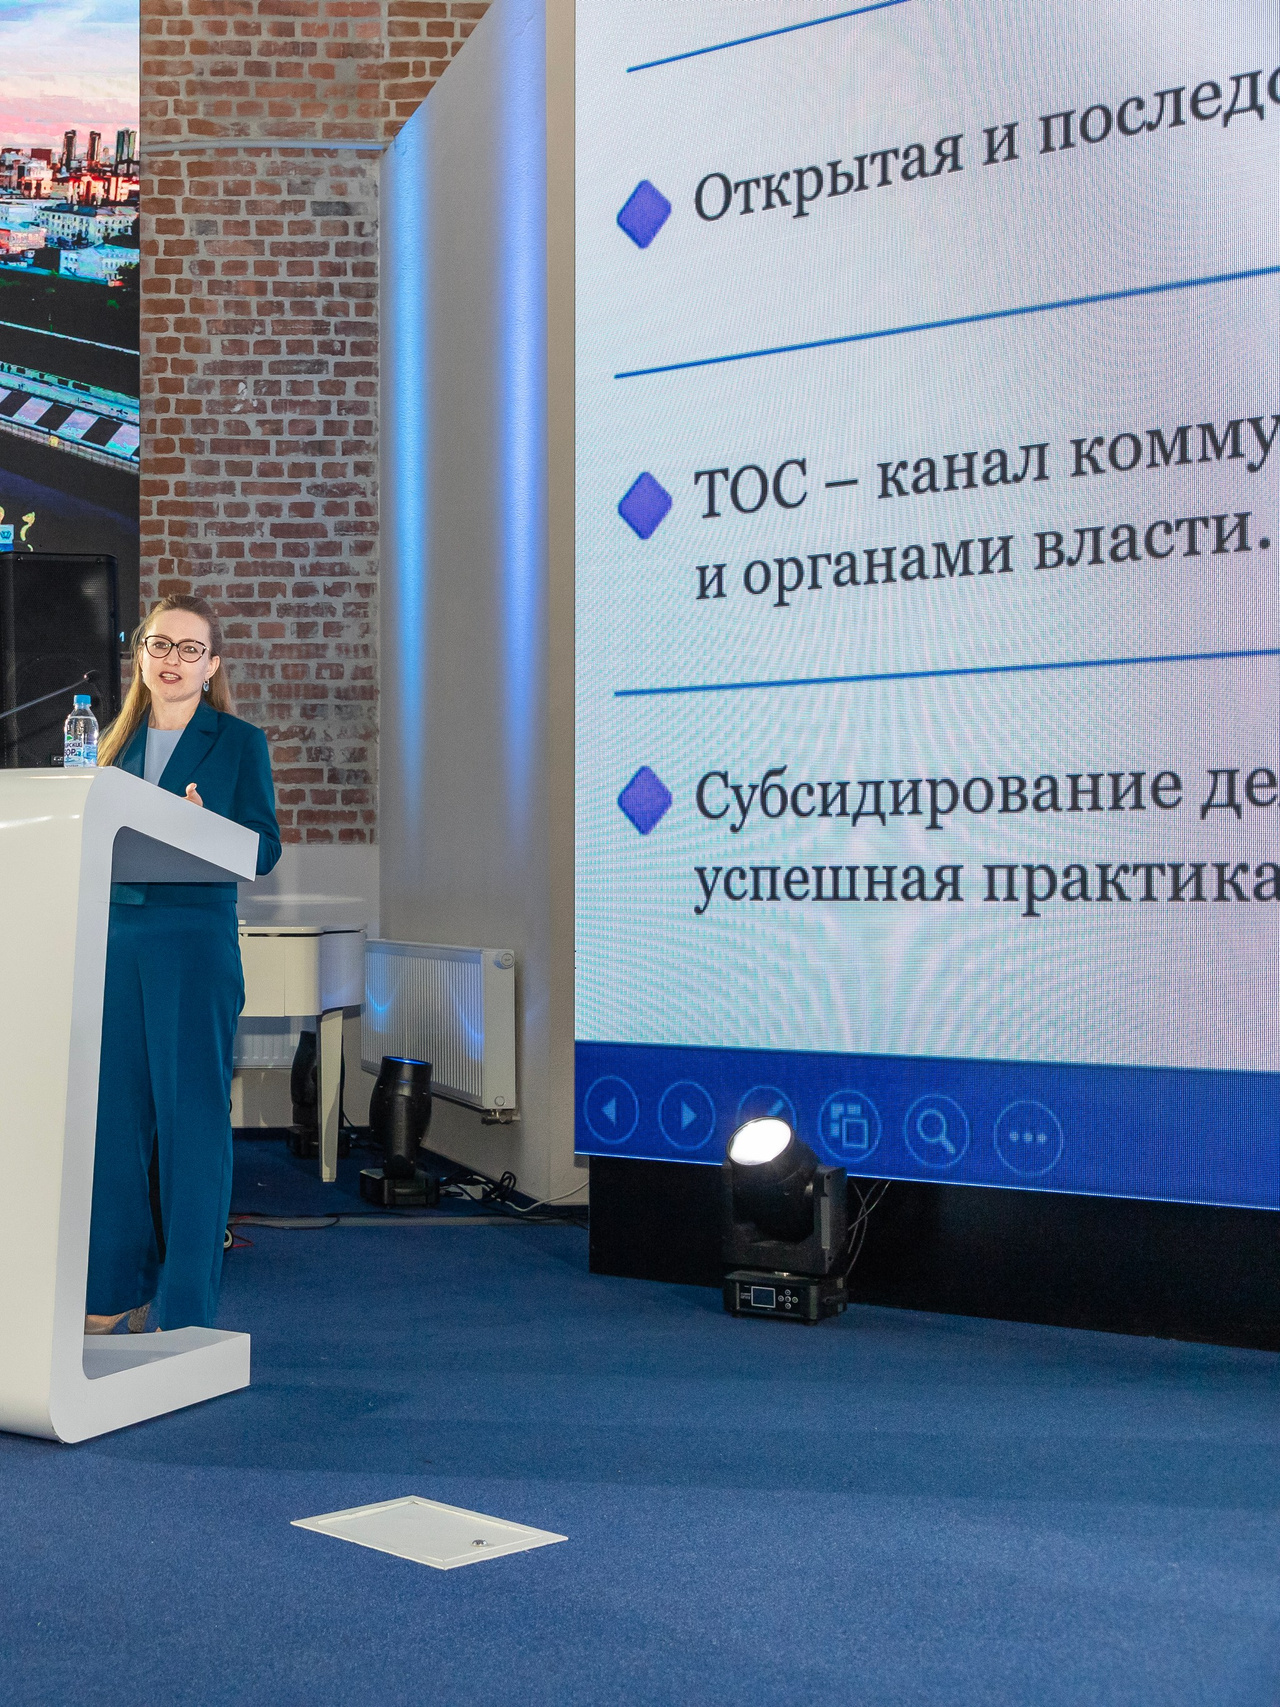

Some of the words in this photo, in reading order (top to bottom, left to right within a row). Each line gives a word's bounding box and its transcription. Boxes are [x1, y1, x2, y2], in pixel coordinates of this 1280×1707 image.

[694, 132, 965, 222] Открытая
[982, 121, 1021, 166] и
[694, 457, 808, 520] ТОС
[876, 441, 1051, 500] канал
[696, 562, 728, 600] и
[743, 534, 1015, 609] органами
[1034, 510, 1272, 571] власти.
[695, 764, 1184, 834] Субсидирование
[694, 863, 964, 916] успешная
[983, 861, 1280, 918] практика
